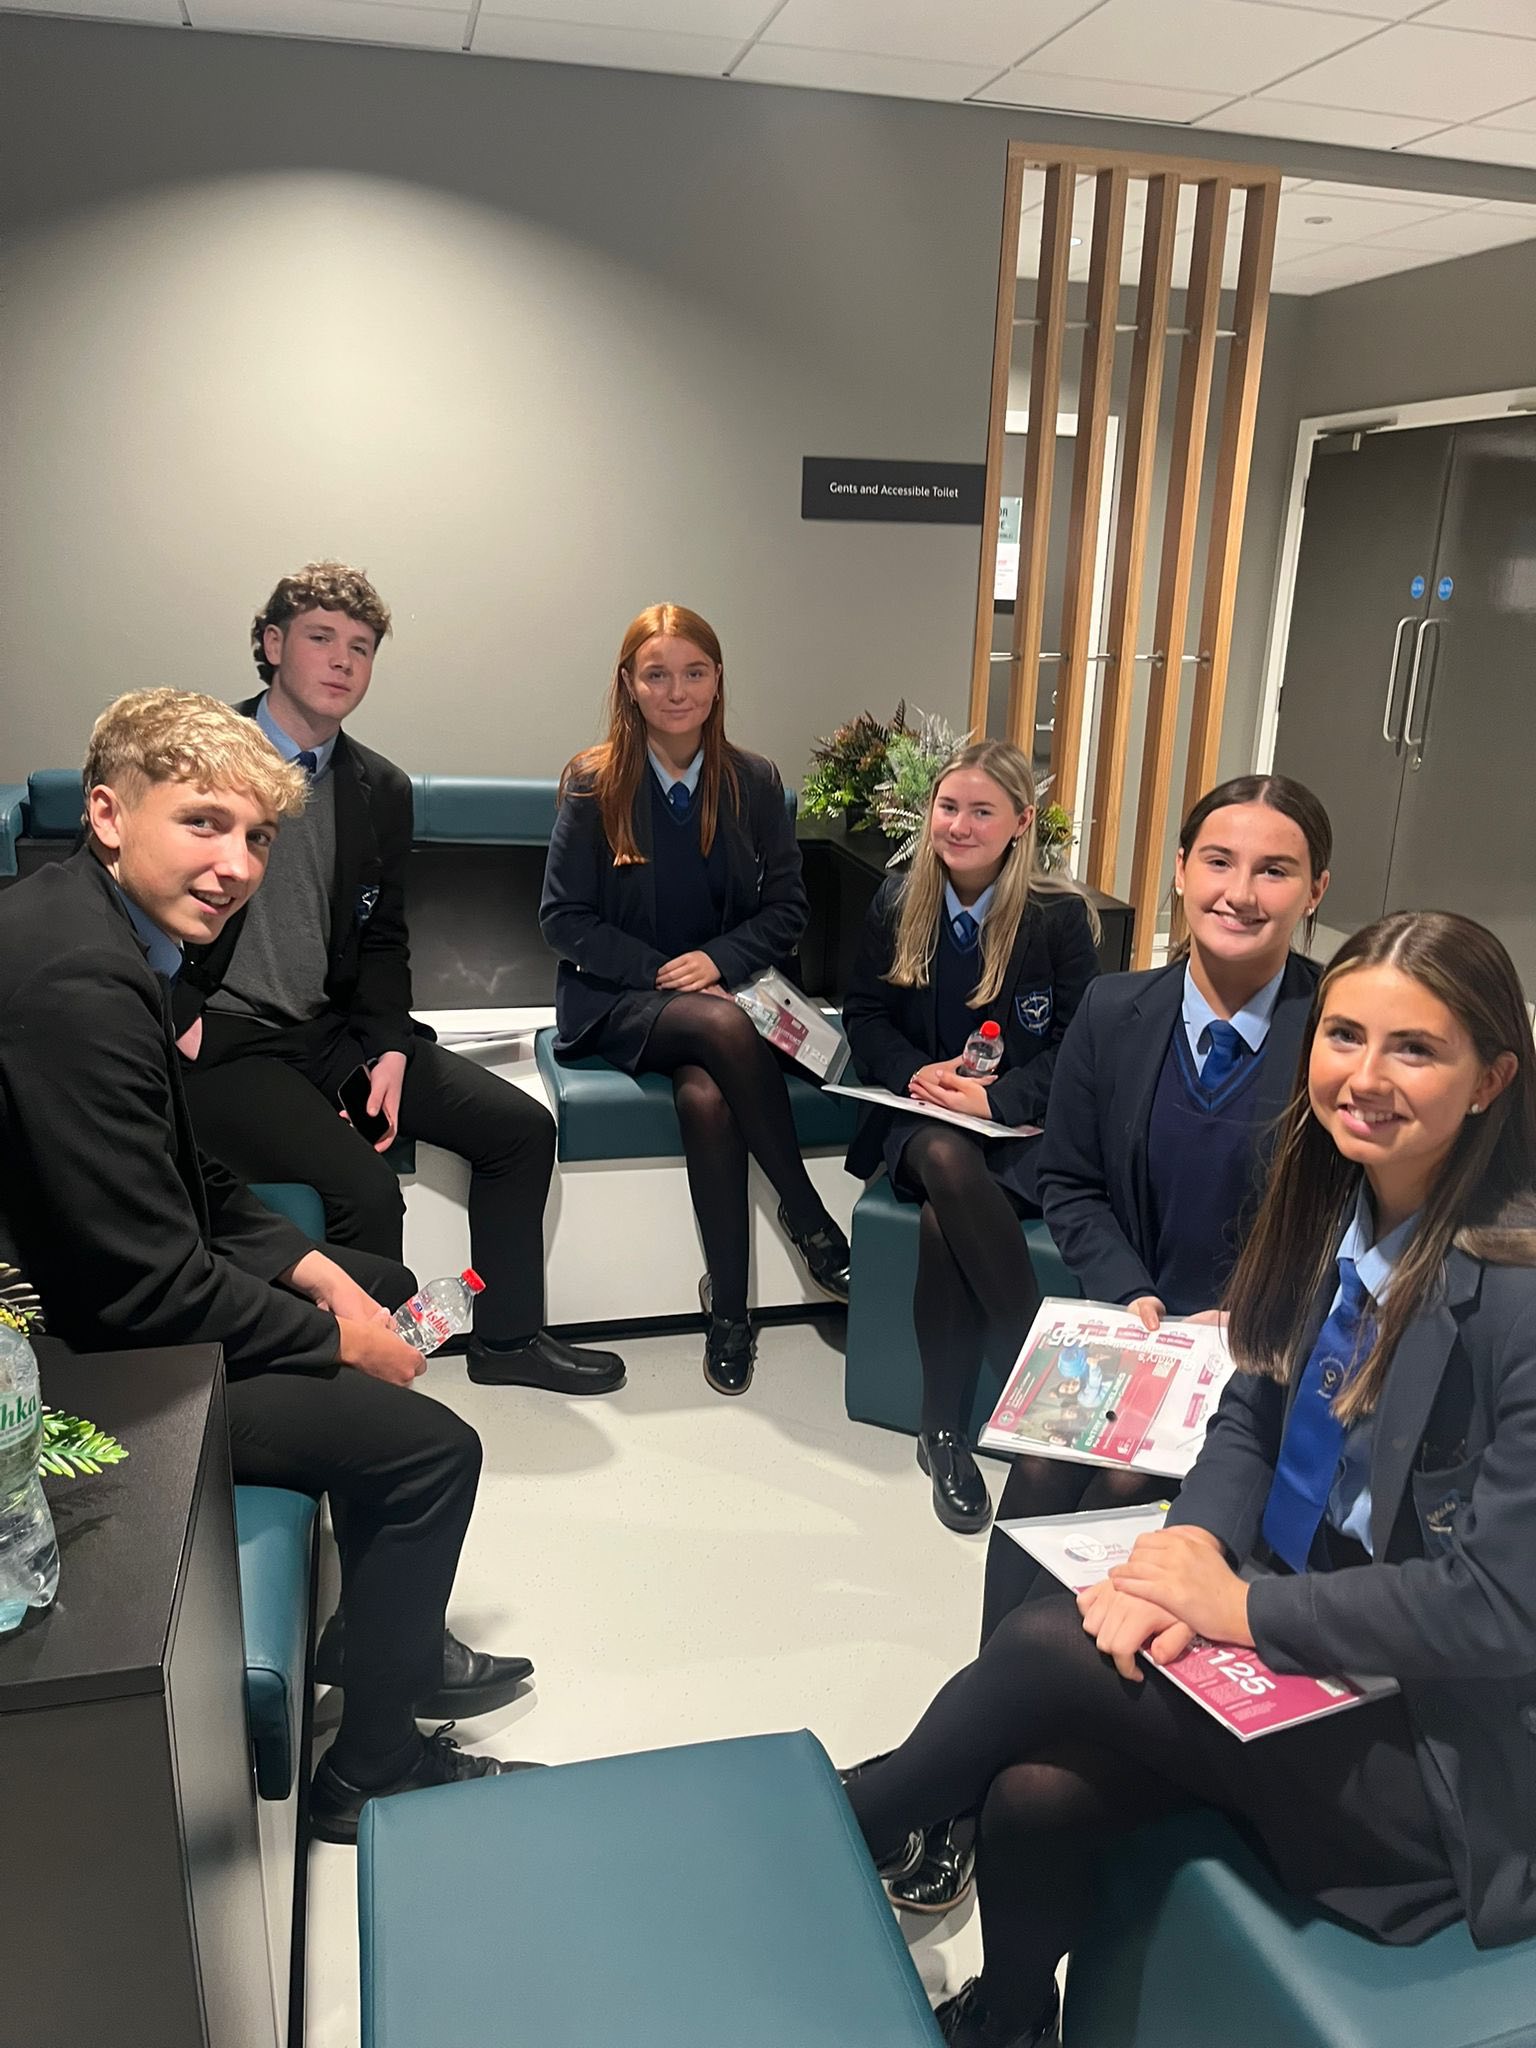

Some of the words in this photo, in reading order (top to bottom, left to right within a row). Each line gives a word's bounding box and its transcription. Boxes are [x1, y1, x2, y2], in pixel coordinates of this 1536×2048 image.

[829, 481, 858, 494] Gents
[860, 484, 879, 494] and
[881, 485, 930, 497] Accessible
[932, 486, 959, 498] Toilet
[425, 1309, 450, 1336] ishka
[1208, 1649, 1277, 1696] 125
